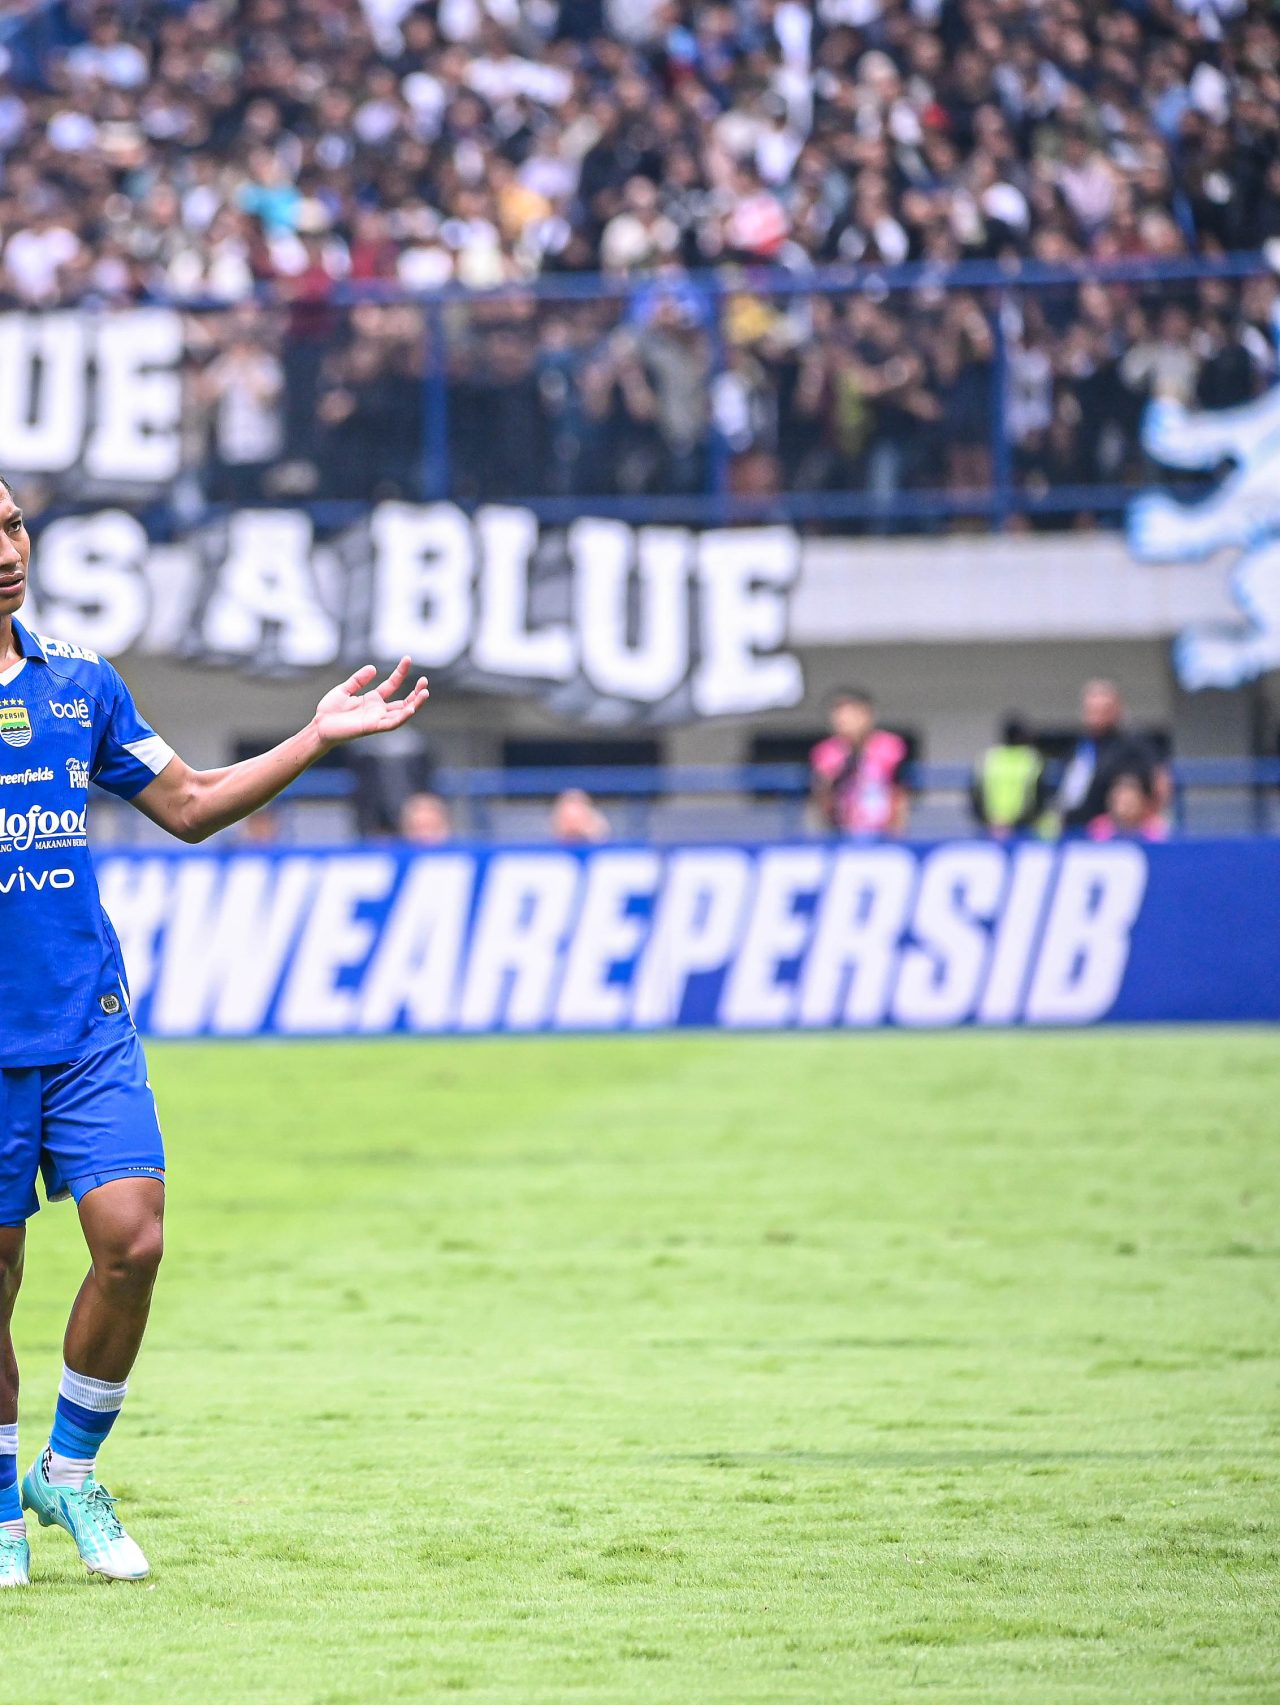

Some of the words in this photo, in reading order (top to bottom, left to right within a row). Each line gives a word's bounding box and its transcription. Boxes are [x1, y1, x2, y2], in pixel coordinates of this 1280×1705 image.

[204, 508, 340, 665] A
[369, 502, 805, 716] BLUE
[0, 711, 25, 720] PERSIB
[34, 838, 72, 850] MAKANAN
